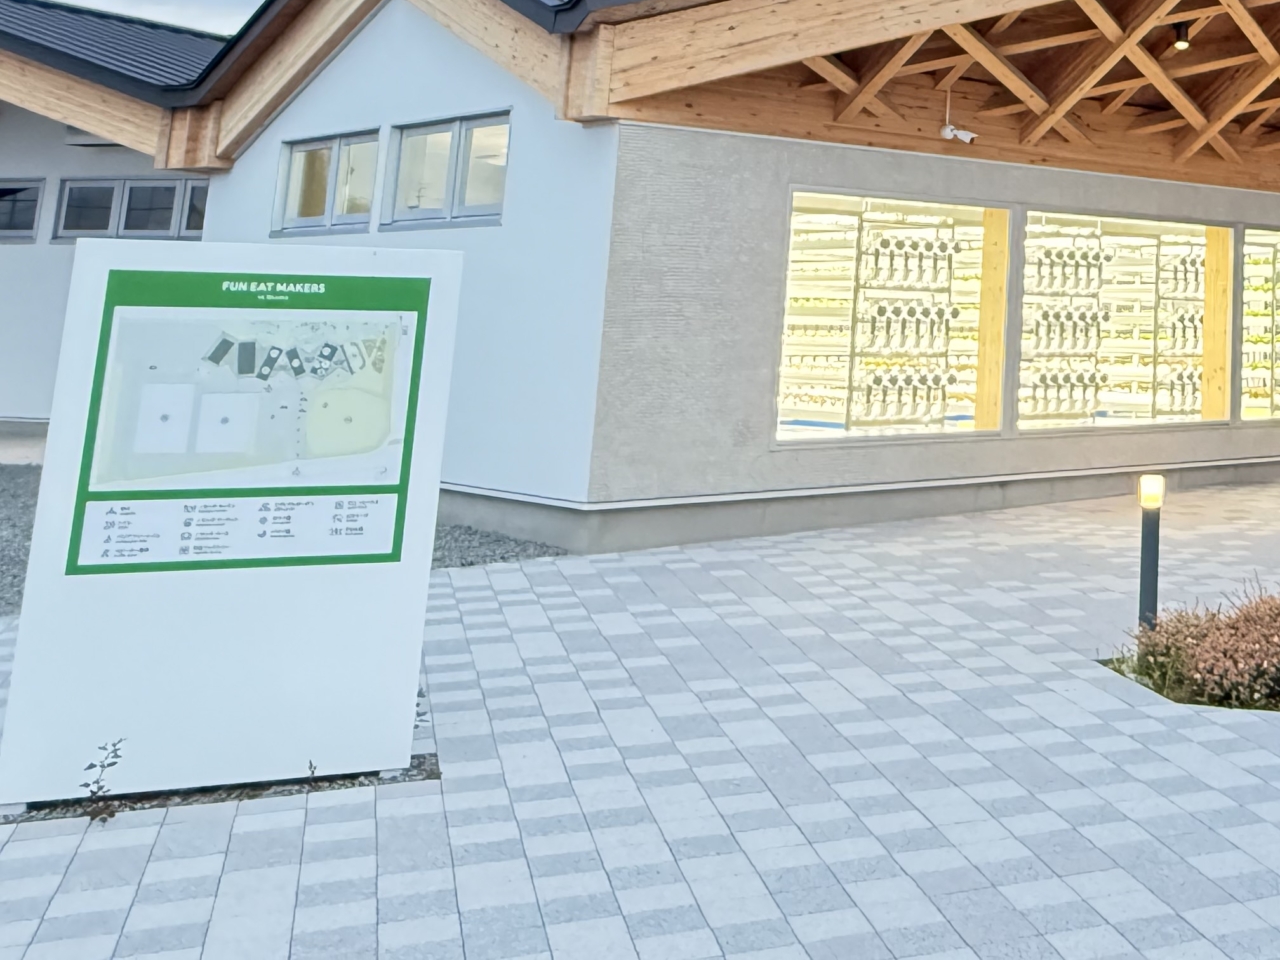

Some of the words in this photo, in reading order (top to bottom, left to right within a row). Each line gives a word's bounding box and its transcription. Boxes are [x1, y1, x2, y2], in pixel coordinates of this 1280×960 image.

[222, 281, 248, 292] FUN
[249, 281, 275, 292] EAT
[276, 282, 326, 294] MAKERS
